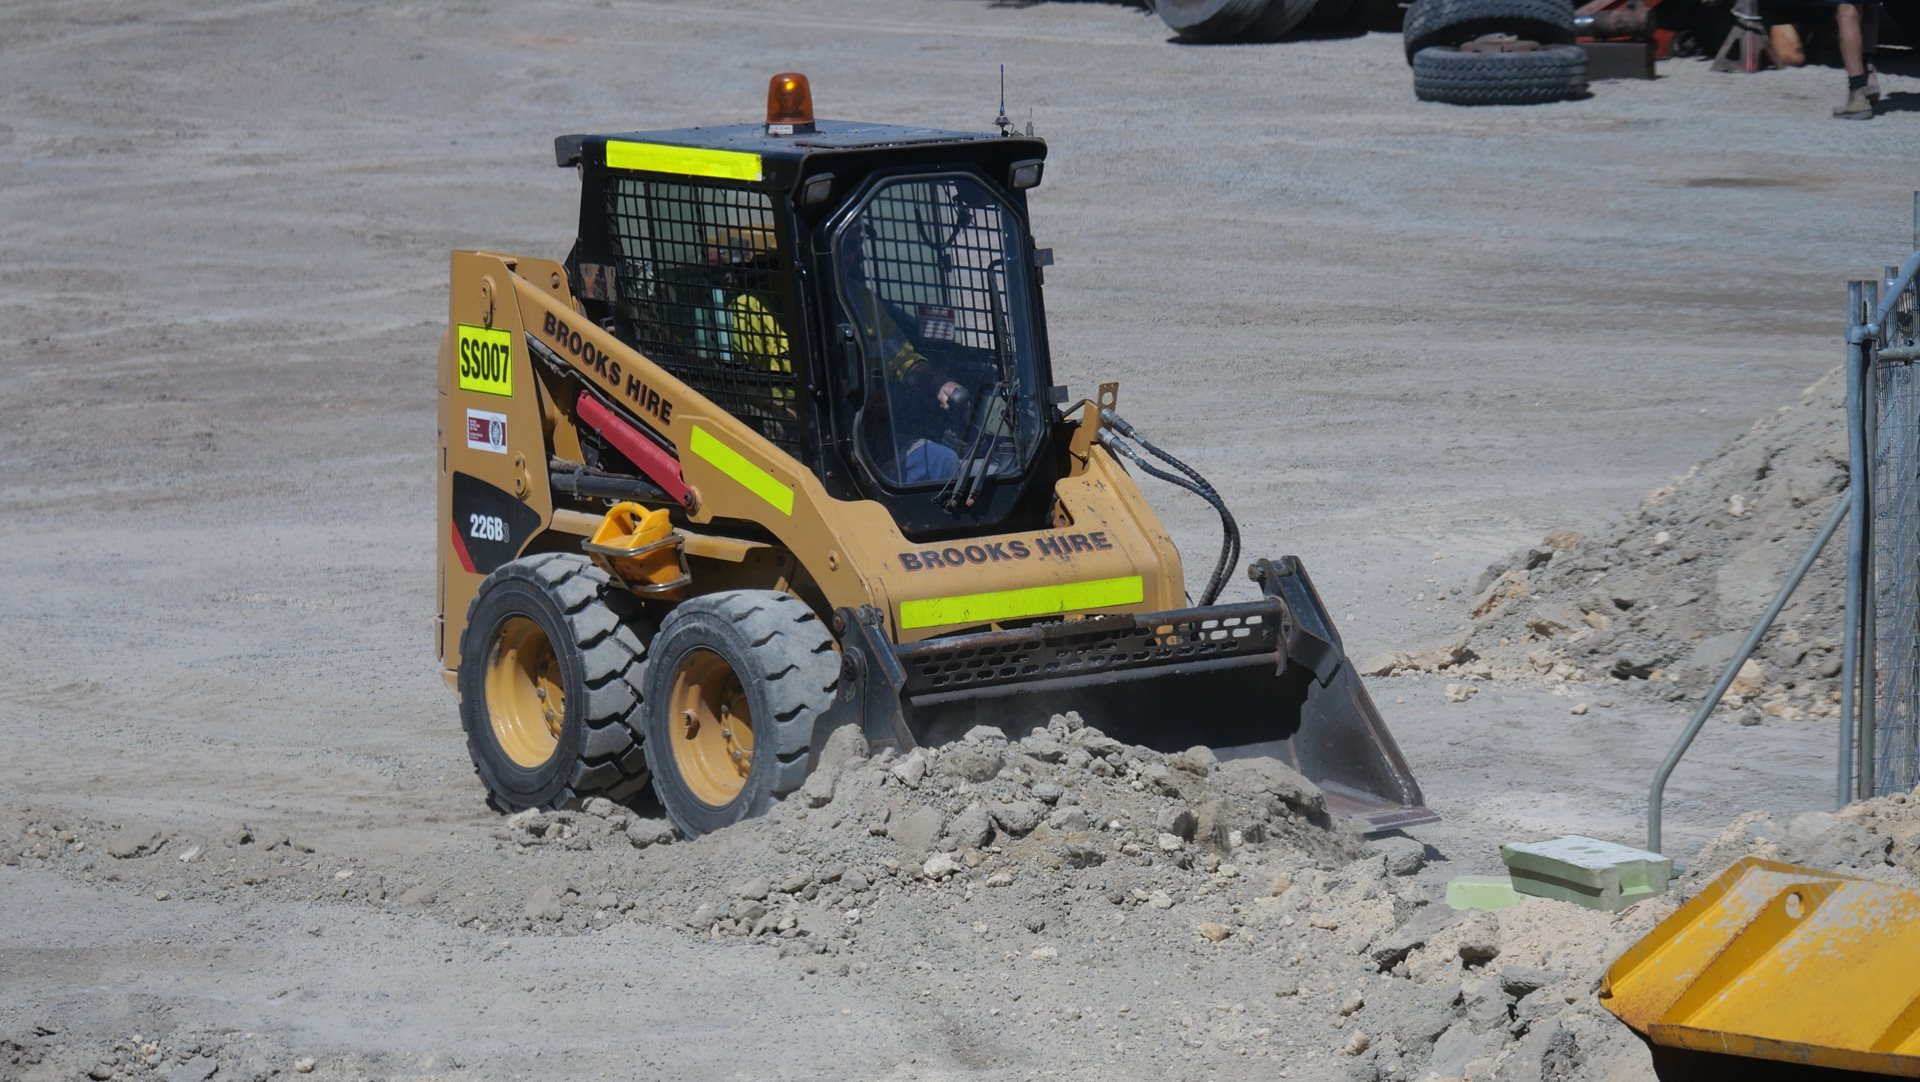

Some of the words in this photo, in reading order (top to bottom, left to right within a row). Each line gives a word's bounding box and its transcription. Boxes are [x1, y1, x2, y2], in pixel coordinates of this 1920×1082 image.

[461, 337, 509, 383] SS007
[543, 310, 622, 386] BROOKS
[625, 373, 673, 426] HIRE
[898, 540, 1031, 572] BROOKS
[1035, 531, 1113, 557] HIRE
